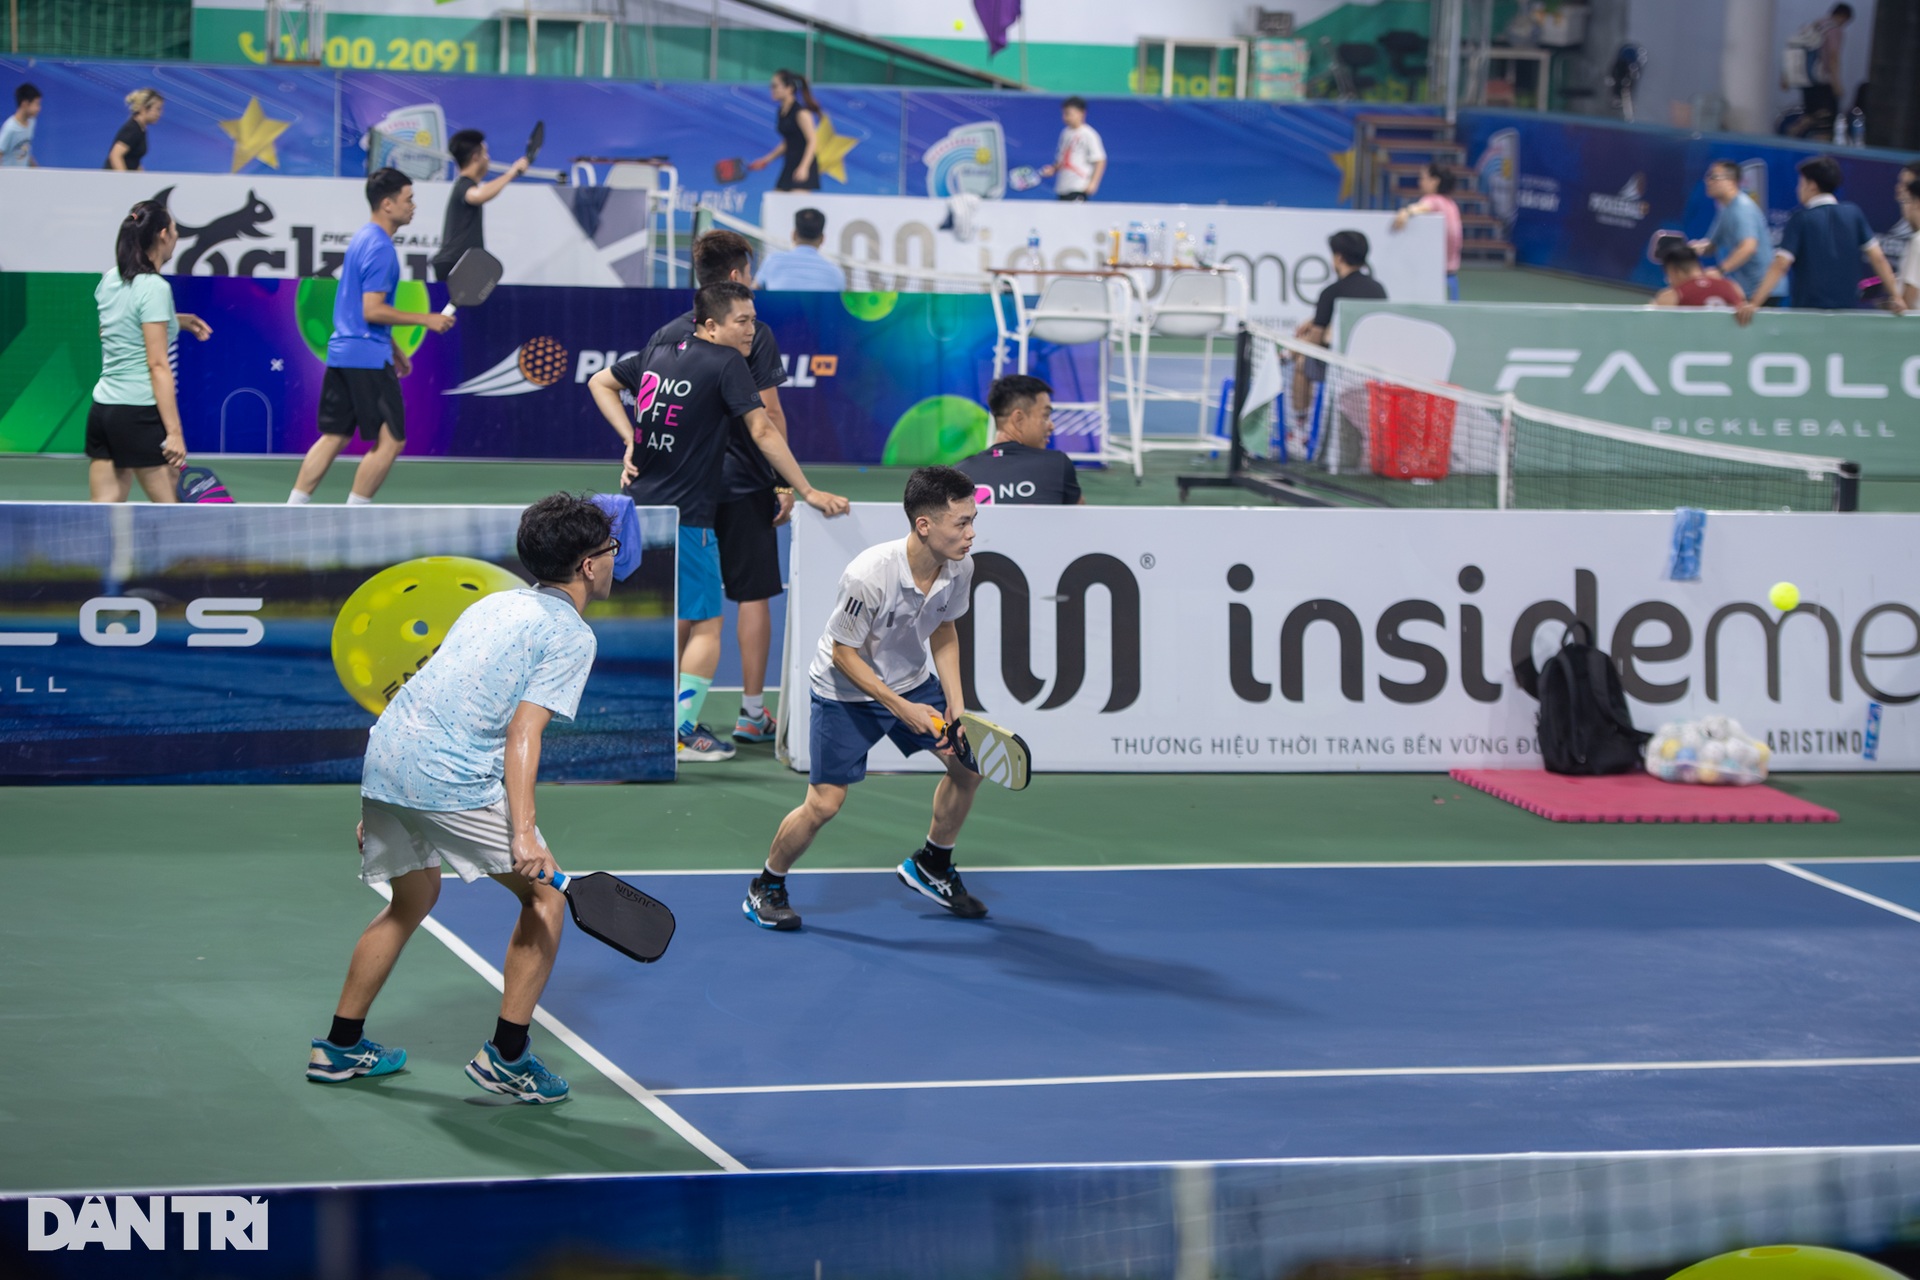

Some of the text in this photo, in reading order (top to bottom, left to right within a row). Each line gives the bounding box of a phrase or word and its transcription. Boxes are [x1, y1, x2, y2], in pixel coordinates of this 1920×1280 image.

[281, 34, 478, 73] 100.2091
[659, 377, 692, 398] NO
[651, 402, 683, 427] FE
[1652, 417, 1896, 438] PICKLEBALL
[647, 432, 675, 453] AR
[999, 481, 1036, 499] NO
[1226, 563, 1920, 706] insideme
[0, 675, 68, 693] LL
[1111, 735, 1202, 755] THƯƠNG
[1211, 733, 1260, 758] HIỆU
[1326, 737, 1396, 755] TRANG
[1767, 730, 1863, 754] ARISTINO
